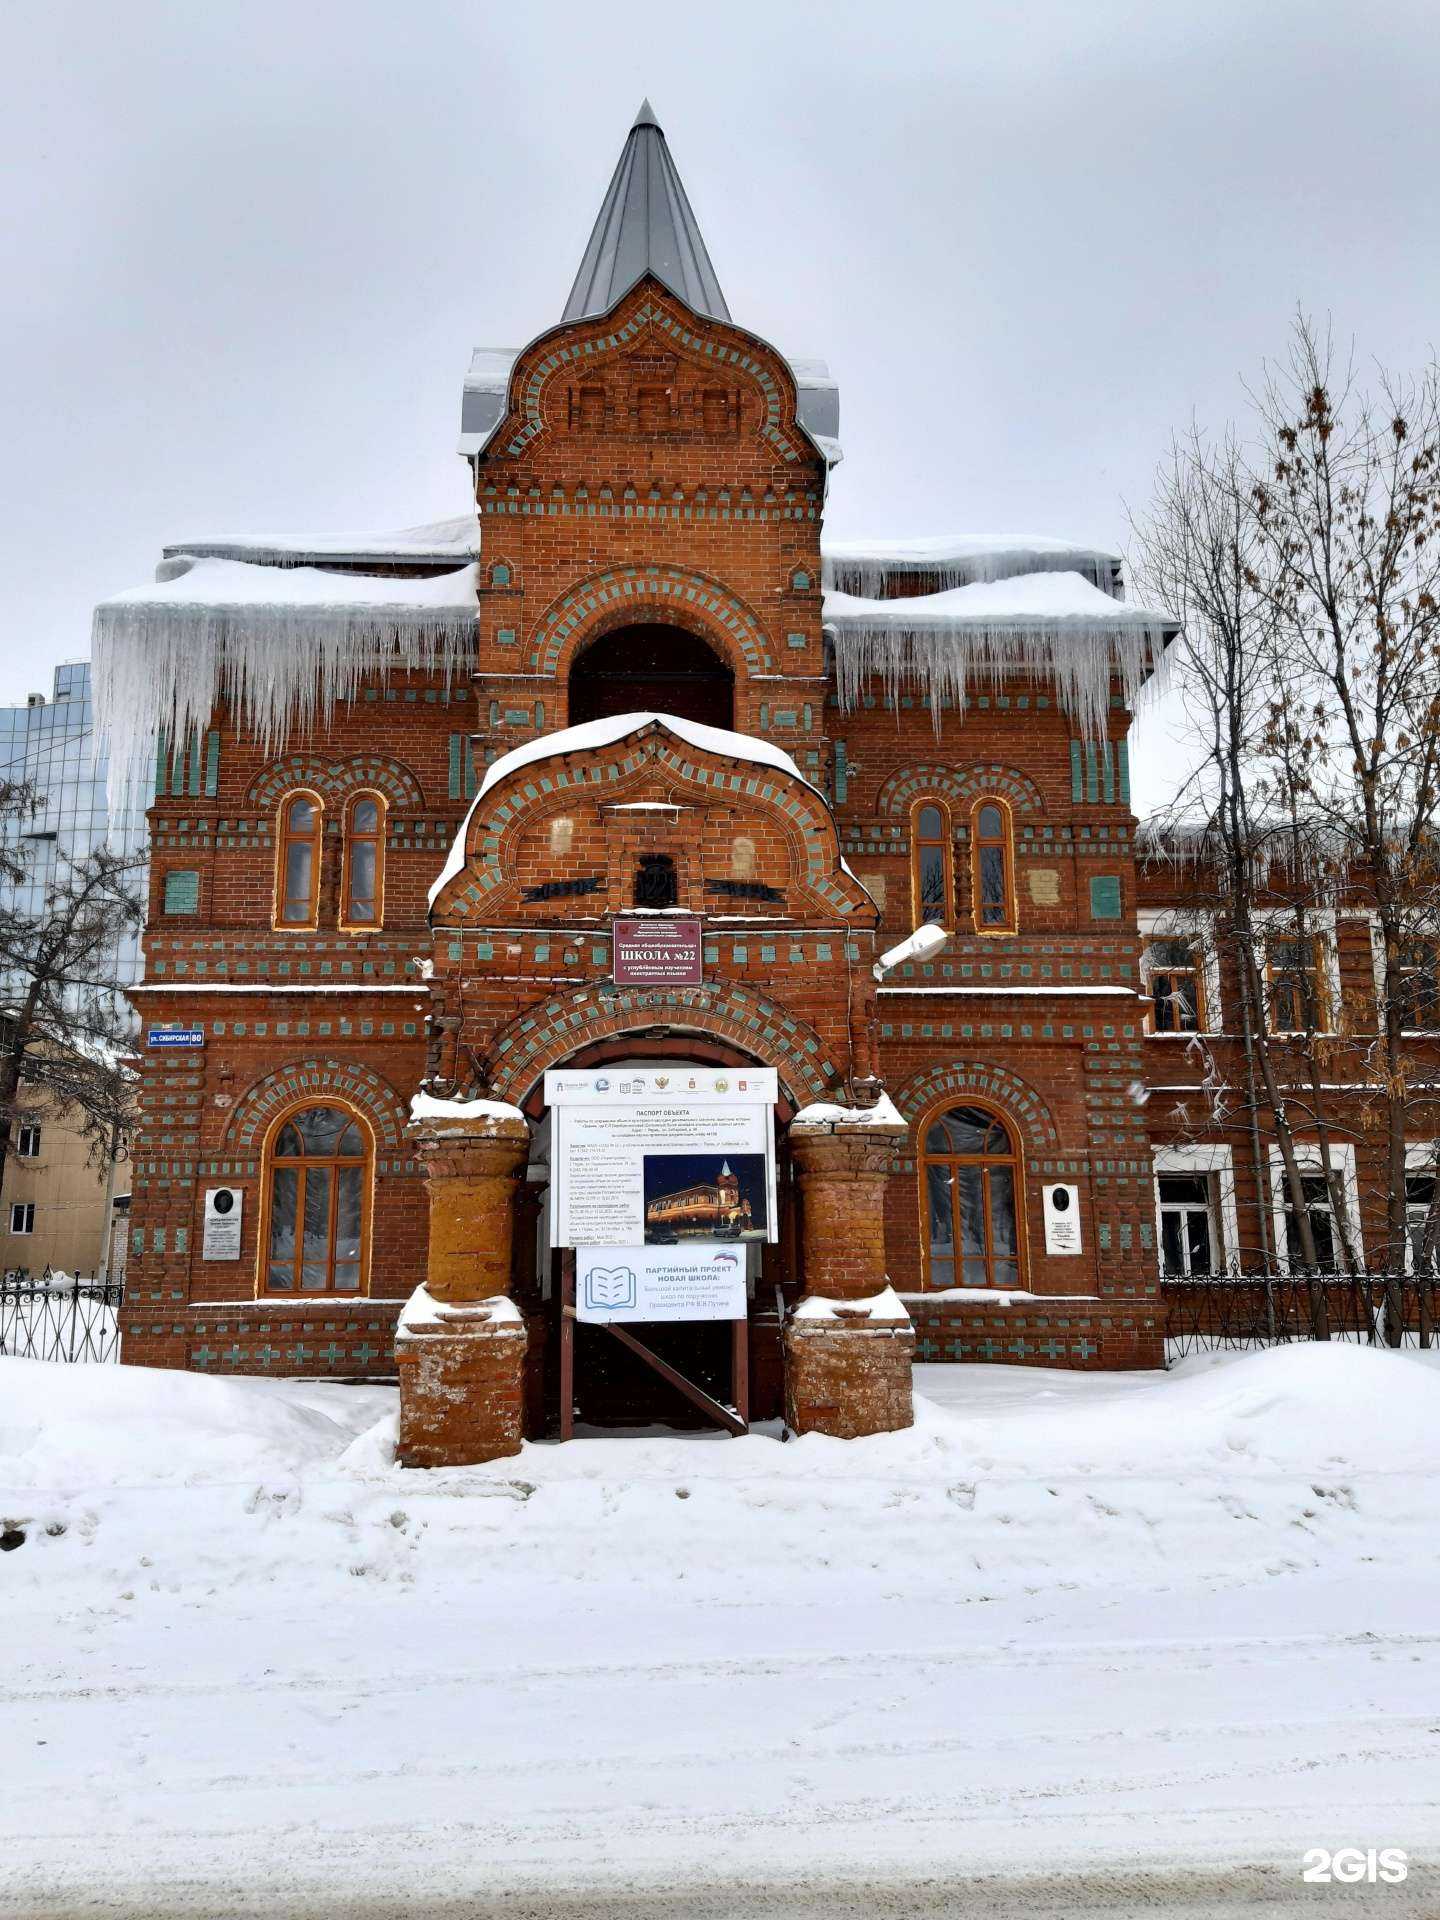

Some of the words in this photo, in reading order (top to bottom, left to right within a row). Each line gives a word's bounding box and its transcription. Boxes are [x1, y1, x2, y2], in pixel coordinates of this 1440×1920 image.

[621, 951, 671, 960] ШКОЛА
[674, 951, 696, 960] №22
[645, 1266, 698, 1274] ПАРТИЙНЫЙ
[700, 1265, 731, 1273] ПРОЕКТ
[688, 1274, 720, 1282] ШКОЛА:
